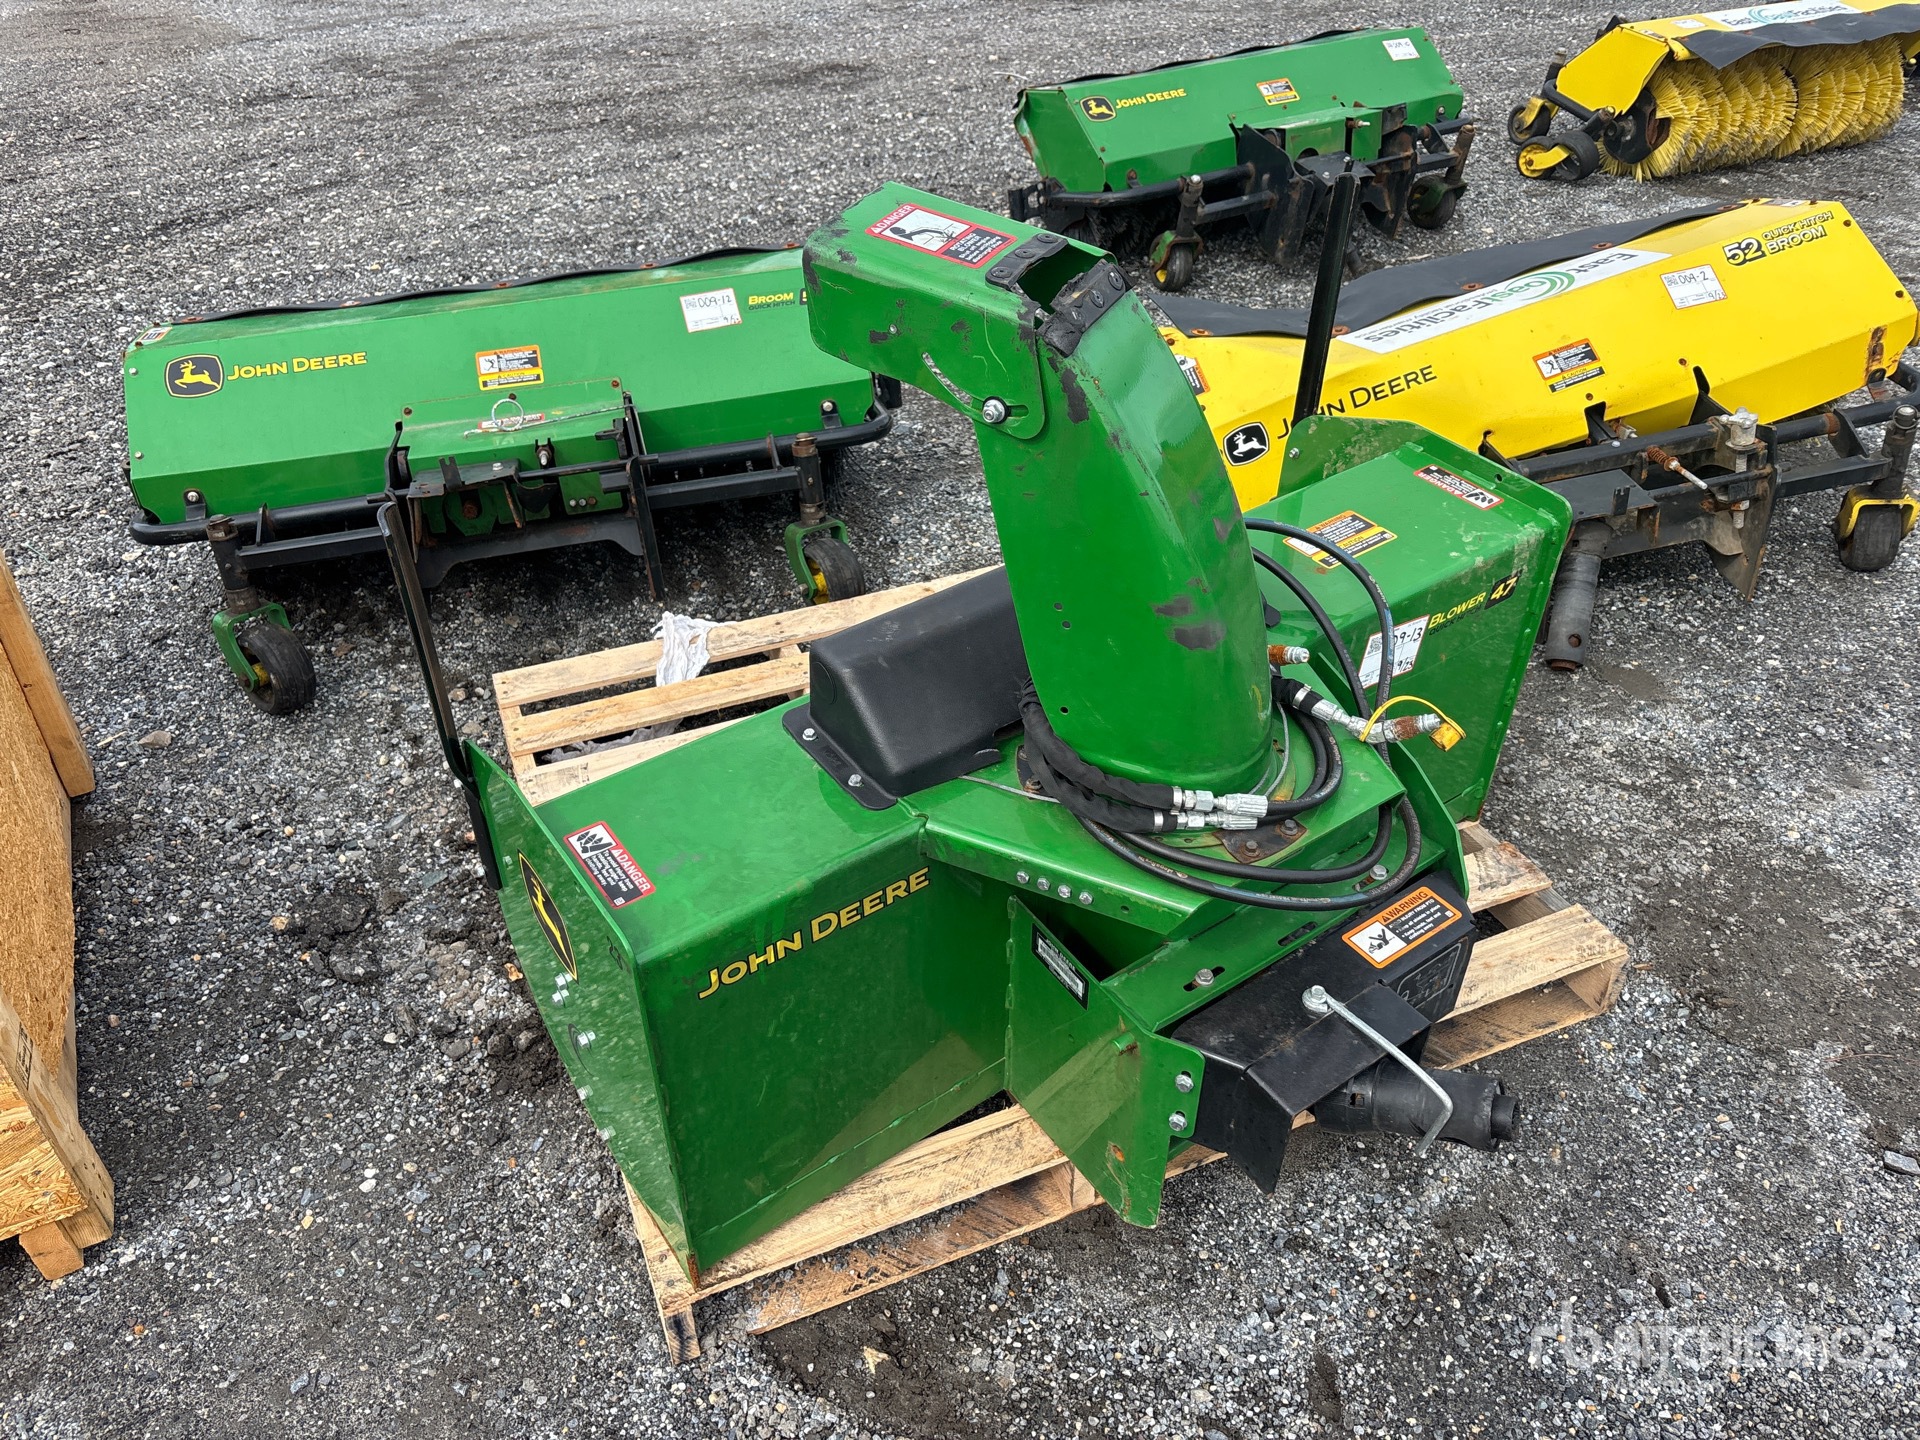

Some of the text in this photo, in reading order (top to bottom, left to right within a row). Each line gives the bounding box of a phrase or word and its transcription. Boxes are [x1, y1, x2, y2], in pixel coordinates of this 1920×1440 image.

[1115, 88, 1187, 109] JOHN DEERE
[878, 204, 914, 229] DANGER
[1722, 210, 1835, 266] 52 QUICK HITCH
[1765, 224, 1827, 255] BROOM
[1566, 252, 1639, 274] East
[1678, 270, 1709, 285] 009-2
[698, 295, 732, 308] 009-12
[748, 292, 794, 306] BROOM
[748, 300, 796, 311] QUICK HITCH
[227, 351, 368, 381] JOHN DEERE
[1349, 364, 1438, 409] DEERE
[1417, 472, 1456, 494] DANGER
[1428, 591, 1488, 630] BLOWER
[1490, 576, 1519, 601] 47
[1429, 620, 1457, 636] QUICK
[617, 854, 651, 892] DANGER
[1386, 890, 1430, 918] WARNING
[697, 929, 804, 1000] JOHN
[810, 866, 931, 943] DEERE
